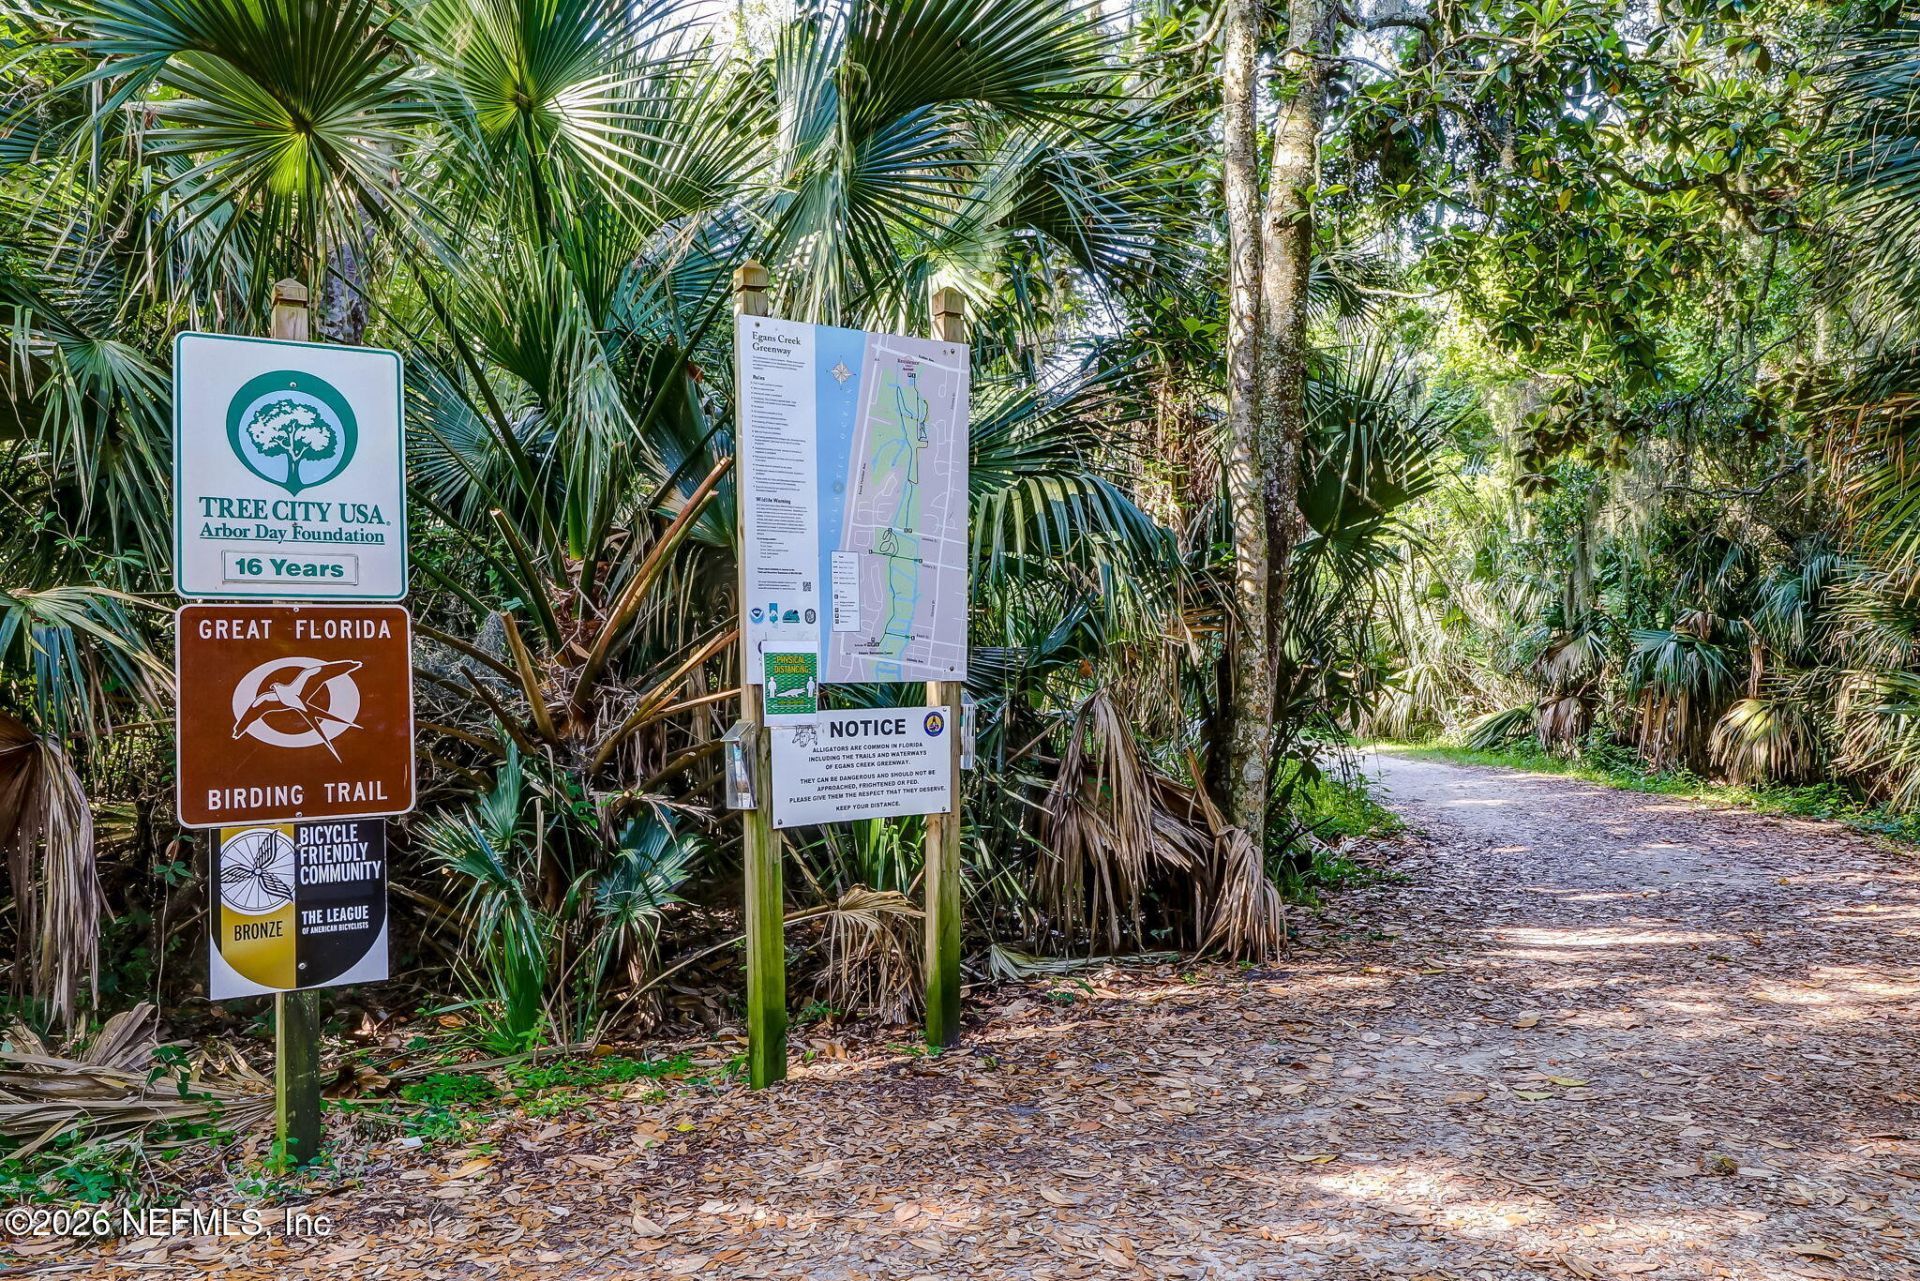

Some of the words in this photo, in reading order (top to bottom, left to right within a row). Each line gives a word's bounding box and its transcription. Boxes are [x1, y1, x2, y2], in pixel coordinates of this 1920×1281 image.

[752, 331, 776, 343] Egans
[778, 334, 801, 345] Creek
[752, 342, 792, 357] Greenway
[199, 497, 268, 520] TREE
[272, 500, 332, 522] CITY
[200, 522, 250, 538] Arbor
[255, 524, 287, 543] Day
[292, 525, 385, 542] Foundation
[235, 557, 263, 575] 16
[269, 558, 344, 577] Years
[199, 619, 272, 640] GREAT
[296, 619, 391, 639] FLORIDA
[774, 665, 809, 674] DISTANCING
[776, 656, 804, 664] PHYSICAL
[830, 719, 906, 738] NOTICE
[813, 745, 849, 753] ALLIGATORS
[208, 785, 304, 810] BIRDING
[324, 780, 388, 803] TRAIL
[817, 784, 858, 792] APPROACHED,
[859, 780, 896, 788] FRIGHTENED
[300, 824, 358, 846] BICYCLE
[300, 842, 368, 865] FRIENDLY
[300, 861, 381, 885] COMMUNITY
[302, 909, 323, 925] THE
[327, 905, 369, 922] LEAGUE
[234, 921, 283, 941] BRONZE
[302, 927, 310, 935] OF
[310, 924, 337, 934] AMERICAN
[339, 921, 369, 931] BICYCLISTS
